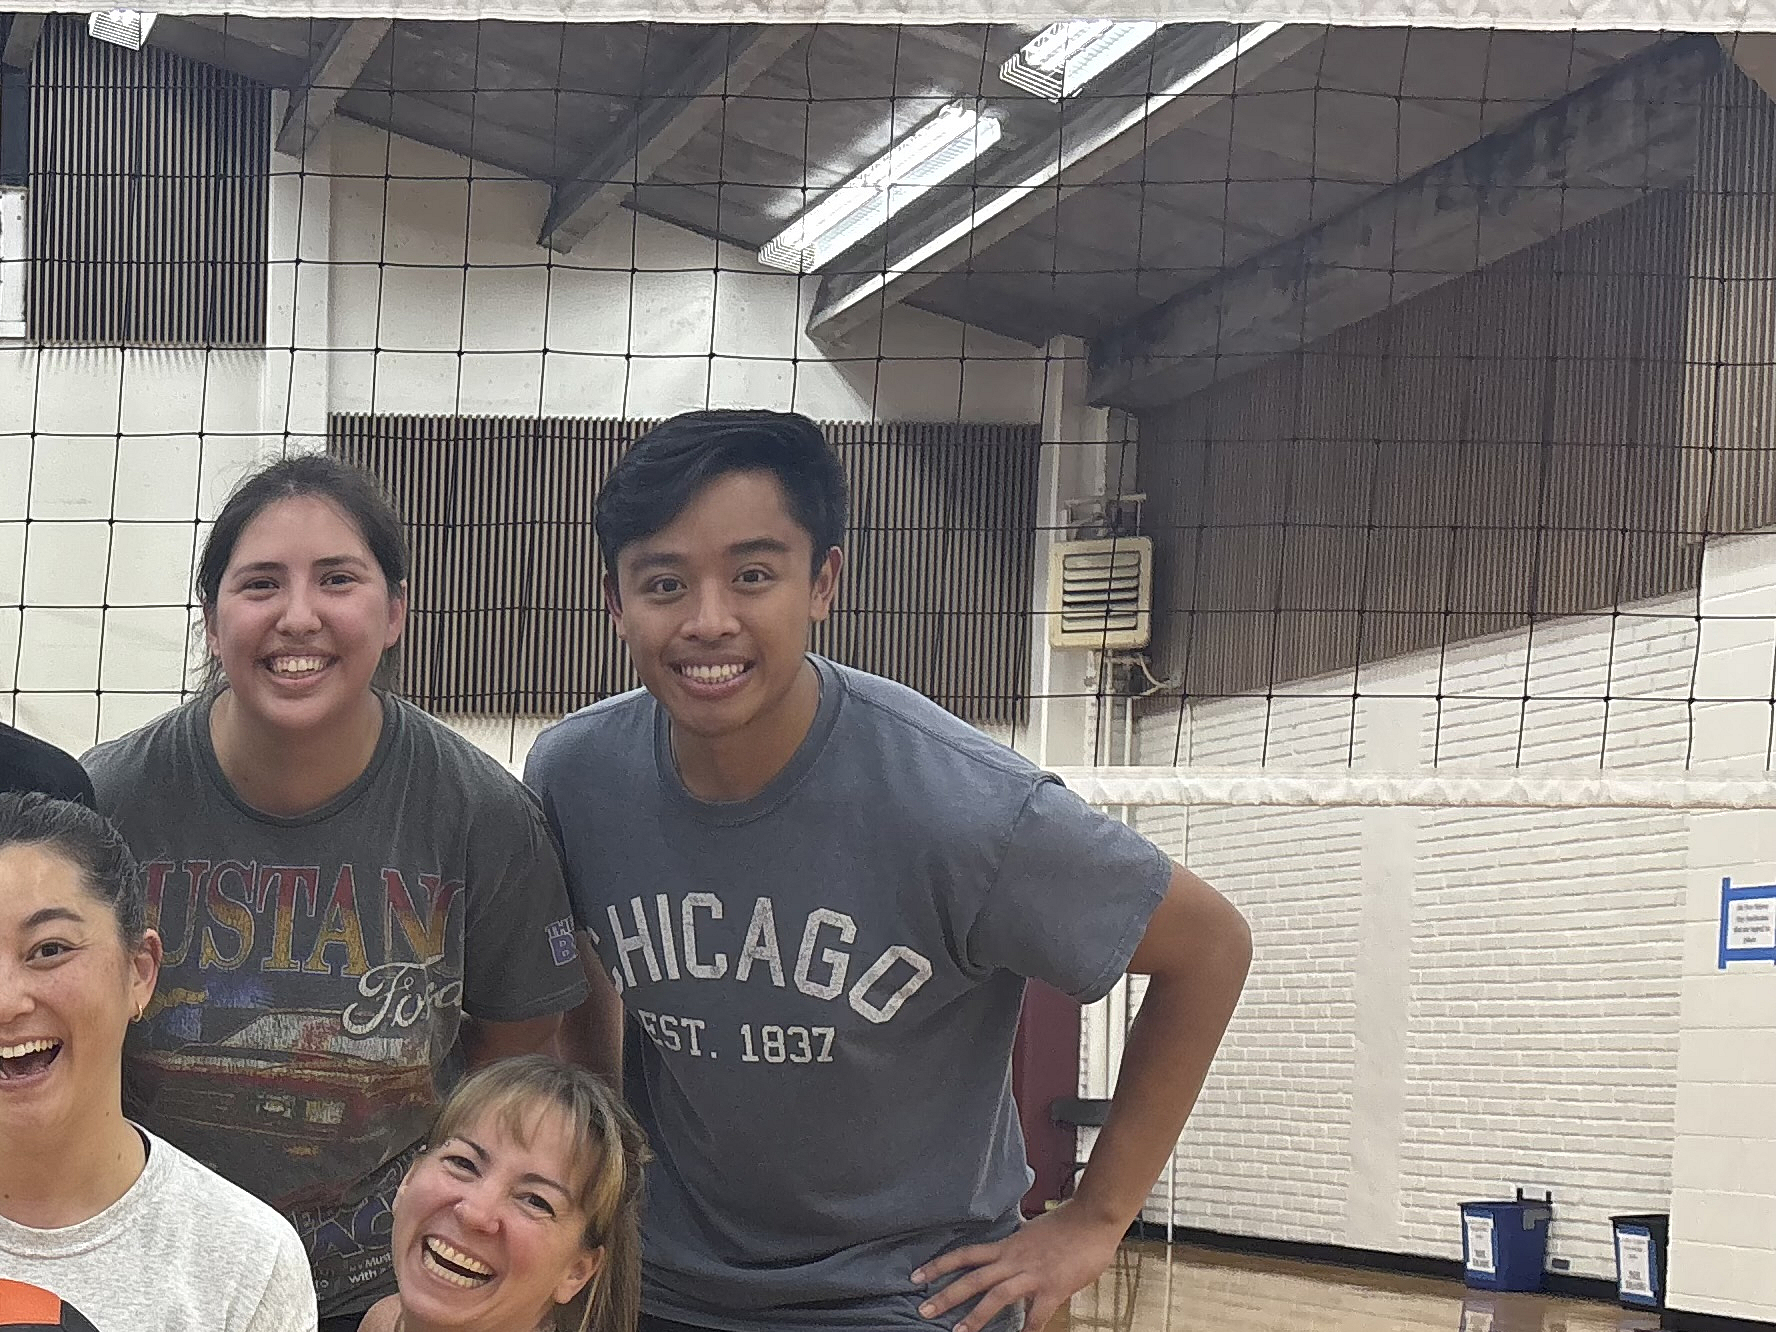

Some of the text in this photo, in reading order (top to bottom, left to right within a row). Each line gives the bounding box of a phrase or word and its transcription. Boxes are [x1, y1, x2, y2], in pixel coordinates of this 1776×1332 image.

[139, 859, 465, 977] USTAN
[342, 954, 463, 1035] Ford
[638, 1009, 835, 1064] EST. 1837
